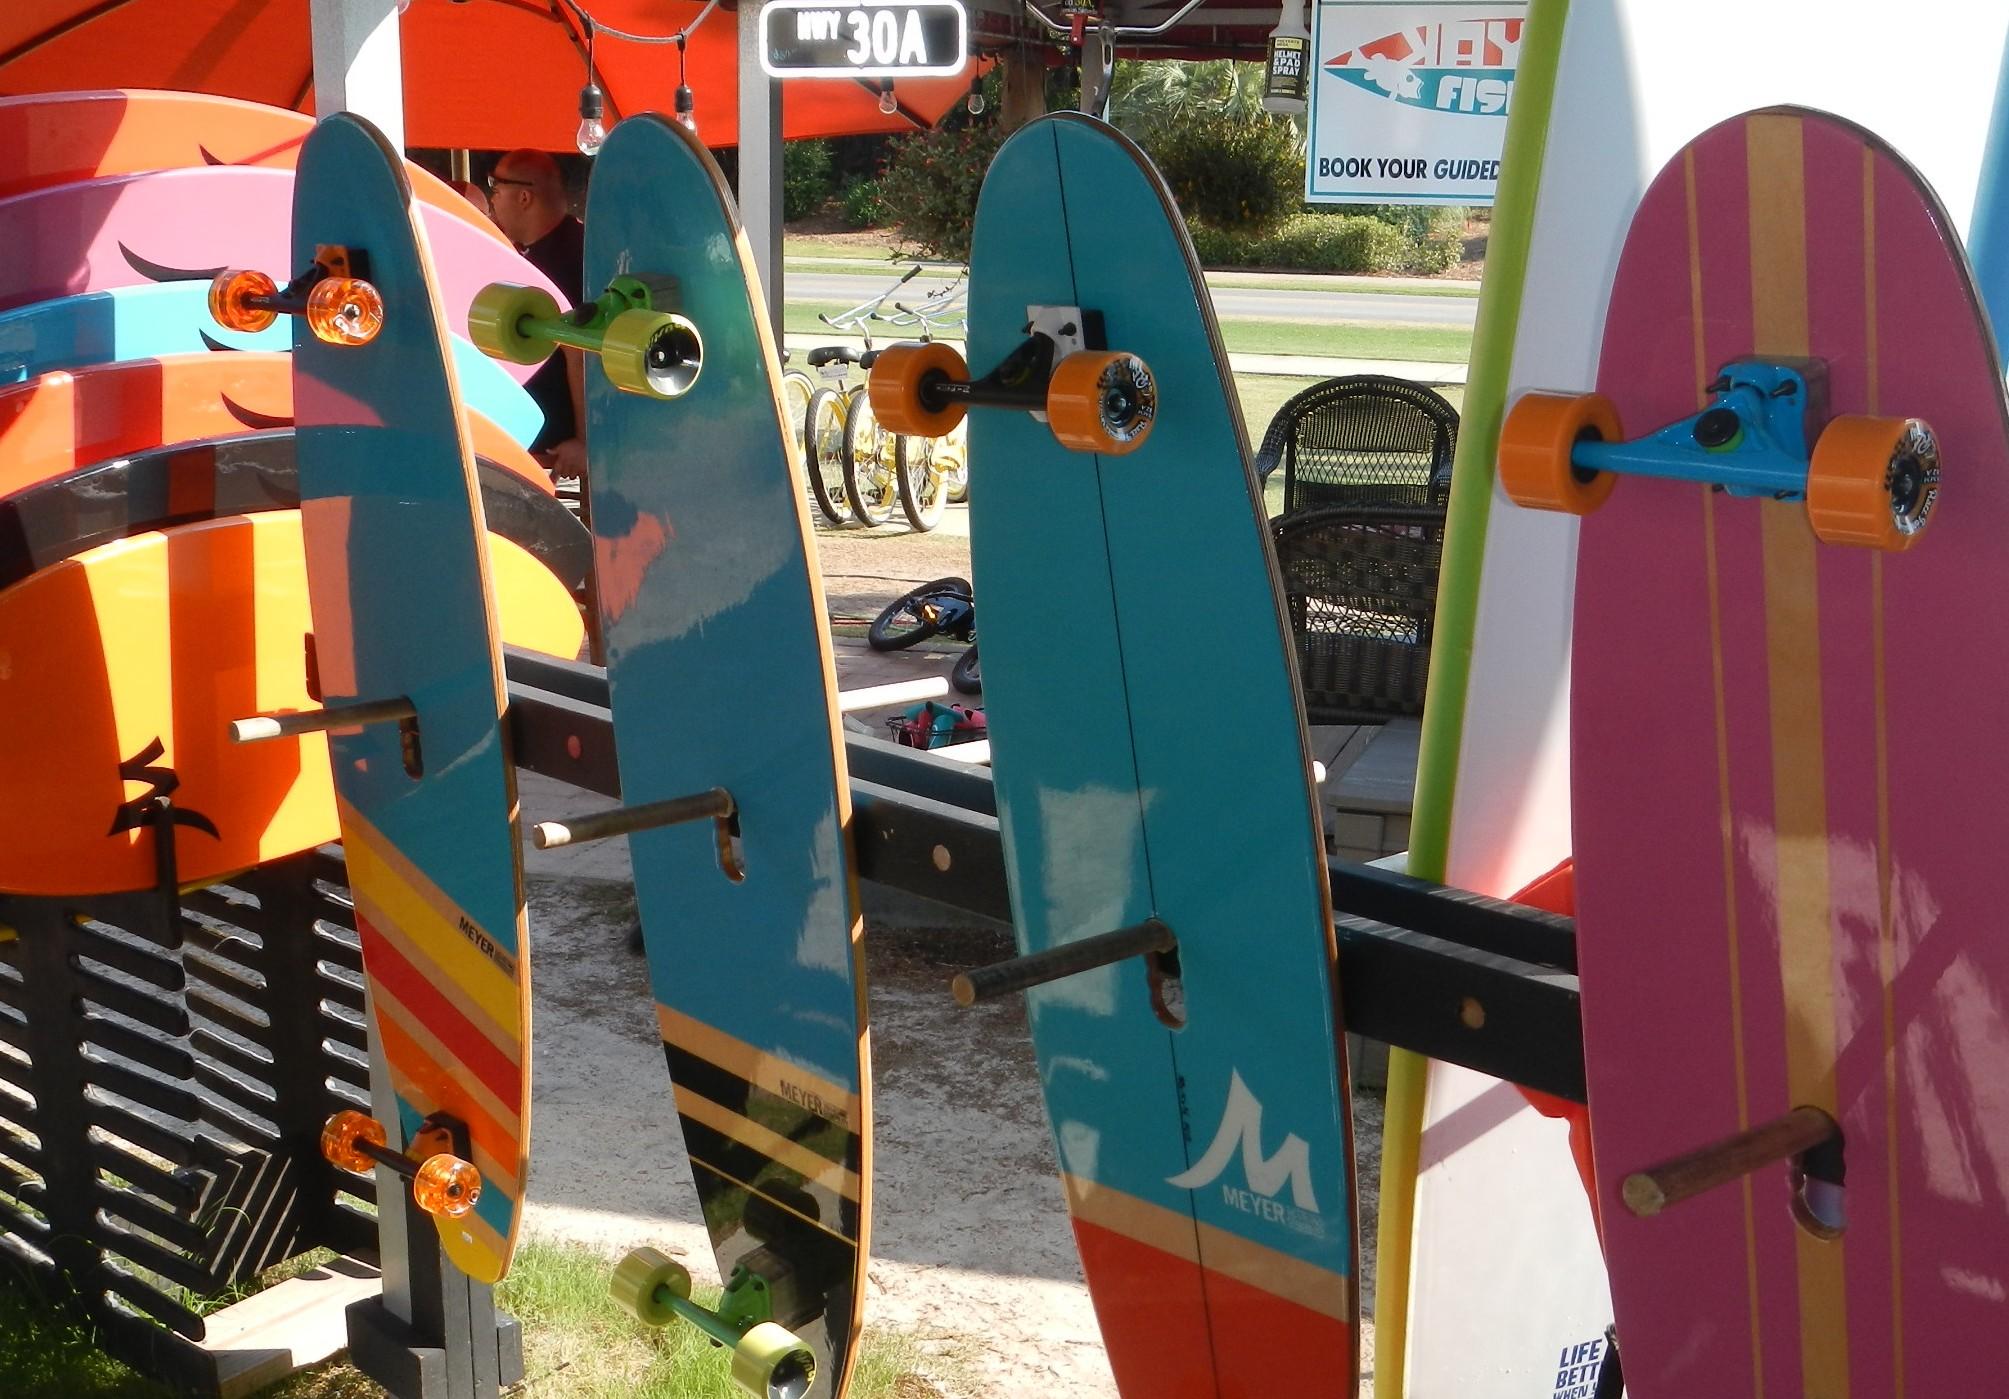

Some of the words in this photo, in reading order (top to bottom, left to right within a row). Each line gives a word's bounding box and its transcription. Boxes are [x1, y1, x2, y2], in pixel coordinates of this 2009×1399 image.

[846, 9, 928, 65] 30A
[1273, 50, 1301, 60] HELMET
[1272, 66, 1300, 76] SPRAY
[1319, 157, 1372, 178] BOOK
[1378, 158, 1427, 179] YOUR
[1433, 160, 1500, 180] GUIDED
[459, 916, 494, 959] MEYER
[780, 1079, 824, 1116] MEYER
[1222, 1184, 1287, 1225] MEYER
[1559, 1338, 1603, 1368] LIFE
[1552, 1384, 1589, 1399] WHEN
